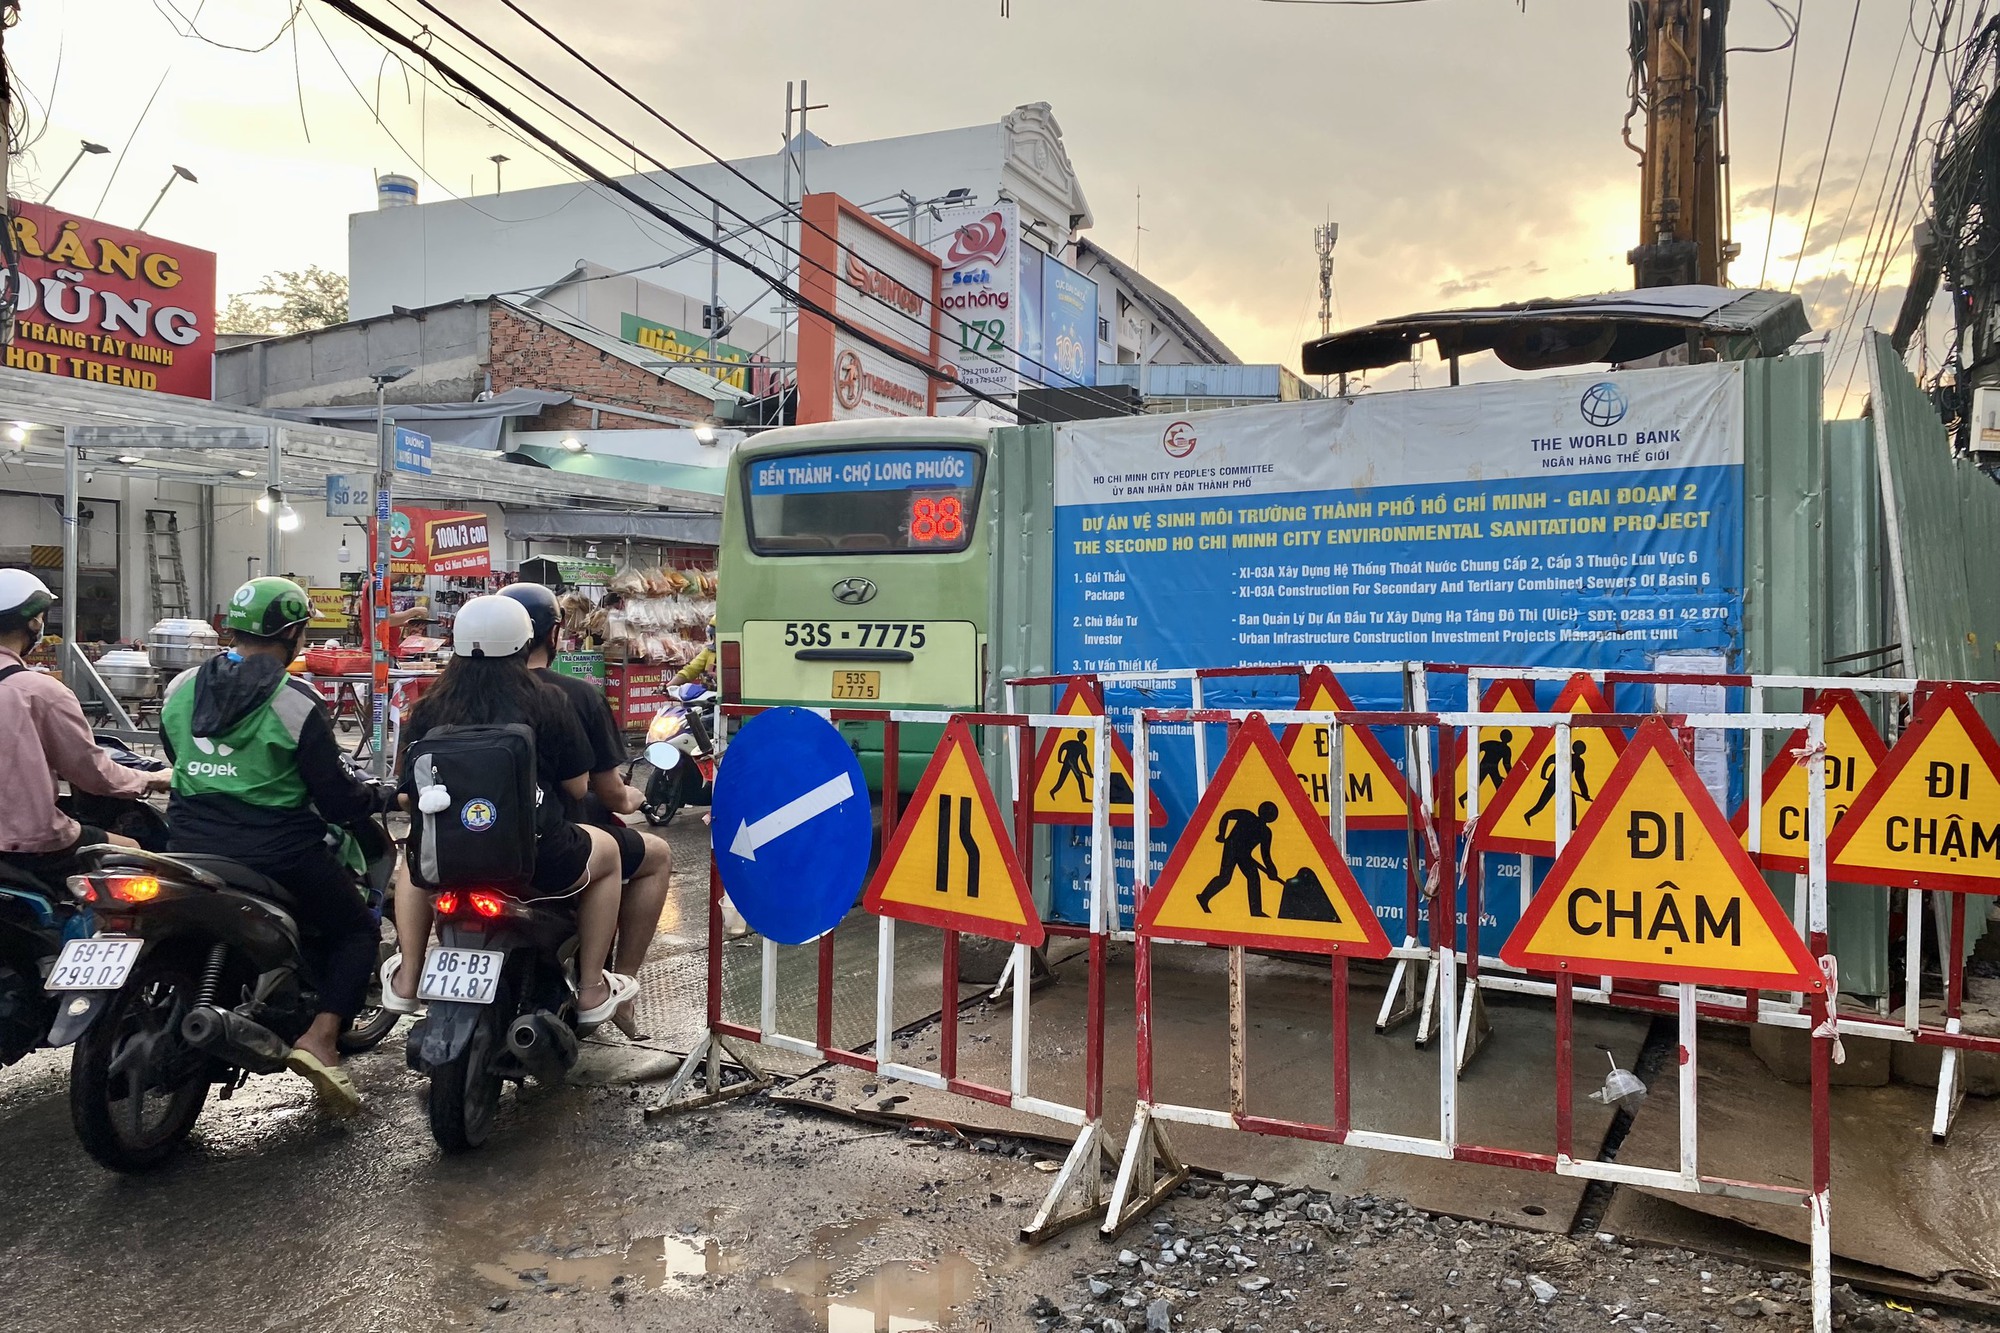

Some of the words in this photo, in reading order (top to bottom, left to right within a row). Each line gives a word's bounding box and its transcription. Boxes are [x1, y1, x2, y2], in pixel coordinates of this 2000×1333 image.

[953, 268, 990, 284] Sách
[19, 320, 85, 349] TRÁNG
[91, 335, 125, 355] TÂY
[131, 343, 173, 365] NINH
[959, 319, 1005, 352] 172
[7, 347, 61, 374] HOT
[70, 358, 157, 390] TREND
[1531, 438, 1562, 451] THE
[1569, 434, 1627, 449] WORLD
[1636, 429, 1680, 444] BANK
[1543, 456, 1574, 468] NGÂN
[1579, 454, 1611, 465] HÀNG
[1617, 449, 1640, 463] THẾ
[1645, 449, 1669, 461] GIỚI
[759, 462, 784, 486] BẾN
[788, 463, 832, 485] THÀNH
[843, 461, 871, 486] CHỢ
[875, 461, 912, 481] LONG
[915, 455, 964, 479] PHƯỚC
[1093, 476, 1104, 485] HO
[1125, 474, 1147, 482] MINH
[1151, 472, 1170, 480] CITY
[1174, 468, 1216, 479] PEOPLE'S
[1219, 464, 1274, 475] COMMITTEE
[335, 486, 349, 504] SỐ
[353, 491, 368, 504] 22
[1112, 486, 1124, 496] ỦY
[1127, 486, 1144, 495] BAN
[1148, 483, 1172, 493] NHÂN
[1176, 481, 1194, 492] DÂN
[1198, 480, 1229, 490] THÀNH
[1233, 476, 1252, 488] PHỐ
[912, 496, 962, 541] 88
[1082, 516, 1105, 534] DỰ
[1107, 513, 1128, 530] ÁN
[1133, 511, 1151, 532] VỆ
[1157, 513, 1195, 528] SINH
[1201, 508, 1233, 525] MÔI
[1238, 504, 1307, 523] TRƯỜNG
[1313, 501, 1372, 520] THÀNH
[1378, 494, 1415, 516] PHỐ
[1421, 492, 1447, 514] HỒ
[1454, 492, 1486, 513] CHÍ
[1493, 492, 1547, 511] MINH
[1568, 489, 1610, 507] GIAI
[1617, 485, 1677, 507] ĐOẠN
[1684, 484, 1697, 500] 2
[435, 525, 468, 548] 100k/3
[470, 525, 487, 543] con
[1074, 541, 1100, 555] THE
[1105, 537, 1167, 553] SECOND
[1173, 536, 1194, 551] HO
[1199, 535, 1226, 550] CHI
[1232, 533, 1277, 548] MINH
[1283, 530, 1321, 545] CITY
[1327, 523, 1483, 545] ENVIRONMENTAL
[1490, 517, 1606, 538] SANITATION
[1614, 511, 1710, 532] PROJECT
[1239, 567, 1275, 579] XI-03A
[1278, 565, 1298, 579] Xây
[1302, 564, 1330, 579] Dựng
[1334, 563, 1349, 578] Hệ
[1352, 561, 1386, 576] Thống
[1390, 561, 1422, 574] Thoát
[1426, 560, 1457, 572] Nước
[1461, 559, 1499, 572] Chung
[1503, 555, 1527, 571] Cấp
[1531, 557, 1543, 570] 2,
[1547, 553, 1571, 569] Cấp
[1575, 556, 1584, 568] 3
[1588, 554, 1628, 570] Thuộc
[1632, 553, 1655, 566] Lưu
[1659, 551, 1685, 566] Vực
[1689, 551, 1698, 564] 6
[1074, 573, 1082, 583] 1.
[1086, 572, 1100, 583] Gói
[1239, 585, 1275, 598] XI-03A
[1278, 584, 1349, 597] Construction
[1353, 583, 1370, 595] For
[1373, 581, 1437, 595] Secondary
[1441, 581, 1463, 593] And
[1468, 579, 1514, 592] Tertiary
[1518, 575, 1583, 591] Combined
[1587, 576, 1636, 589] Sewers
[1641, 574, 1655, 587] Of
[1659, 573, 1697, 586] Basin
[1702, 572, 1710, 585] 6
[230, 609, 246, 618] gojek
[1073, 616, 1082, 627] 2.
[1085, 615, 1103, 626] Chủ
[1126, 616, 1138, 626] Tư
[1239, 613, 1259, 625] Ban
[1263, 611, 1290, 625] Quản
[1293, 611, 1305, 625] Lý
[1308, 612, 1324, 626] Dự
[1370, 611, 1383, 624] Tư
[1387, 611, 1408, 624] Xây
[1412, 611, 1442, 625] Dựng
[1446, 611, 1462, 624] Hạ
[1499, 609, 1514, 621] Đô
[1519, 608, 1537, 623] Thị
[1588, 610, 1617, 621] SĐT:
[1621, 609, 1655, 621] 0283
[1659, 608, 1674, 620] 91
[1680, 608, 1698, 620] 42
[1702, 607, 1728, 620] 870
[784, 623, 832, 647] 53S
[857, 624, 926, 648] 7775
[1085, 634, 1122, 645] Investor
[1239, 633, 1270, 644] Urban
[1274, 632, 1350, 644] Infrastructure
[1354, 630, 1427, 643] Construction
[1432, 631, 1499, 643] Investment
[1503, 629, 1555, 643] Projects
[1560, 629, 1646, 642] Management
[1651, 629, 1678, 639] Unit
[1073, 660, 1081, 670] 3.
[1084, 660, 1096, 670] Tư
[1098, 658, 1115, 671] Vấn
[1118, 658, 1141, 671] Thiết
[1145, 658, 1158, 670] Kế
[845, 673, 866, 684] 53S
[837, 686, 874, 697] 7775
[187, 761, 238, 777] gojek
[1925, 761, 1970, 800] ĐI
[1627, 810, 1684, 861] ĐI
[1886, 813, 2000, 862] CHẬM
[1366, 856, 1399, 869] 2024/
[1073, 880, 1081, 890] 8.
[1376, 906, 1404, 919] 0701
[1568, 880, 1741, 954] CHẬM
[70, 941, 127, 964] 69-F1
[435, 949, 490, 976] 86-B3
[48, 965, 126, 988] 299.02
[422, 976, 494, 1000] 714.87
